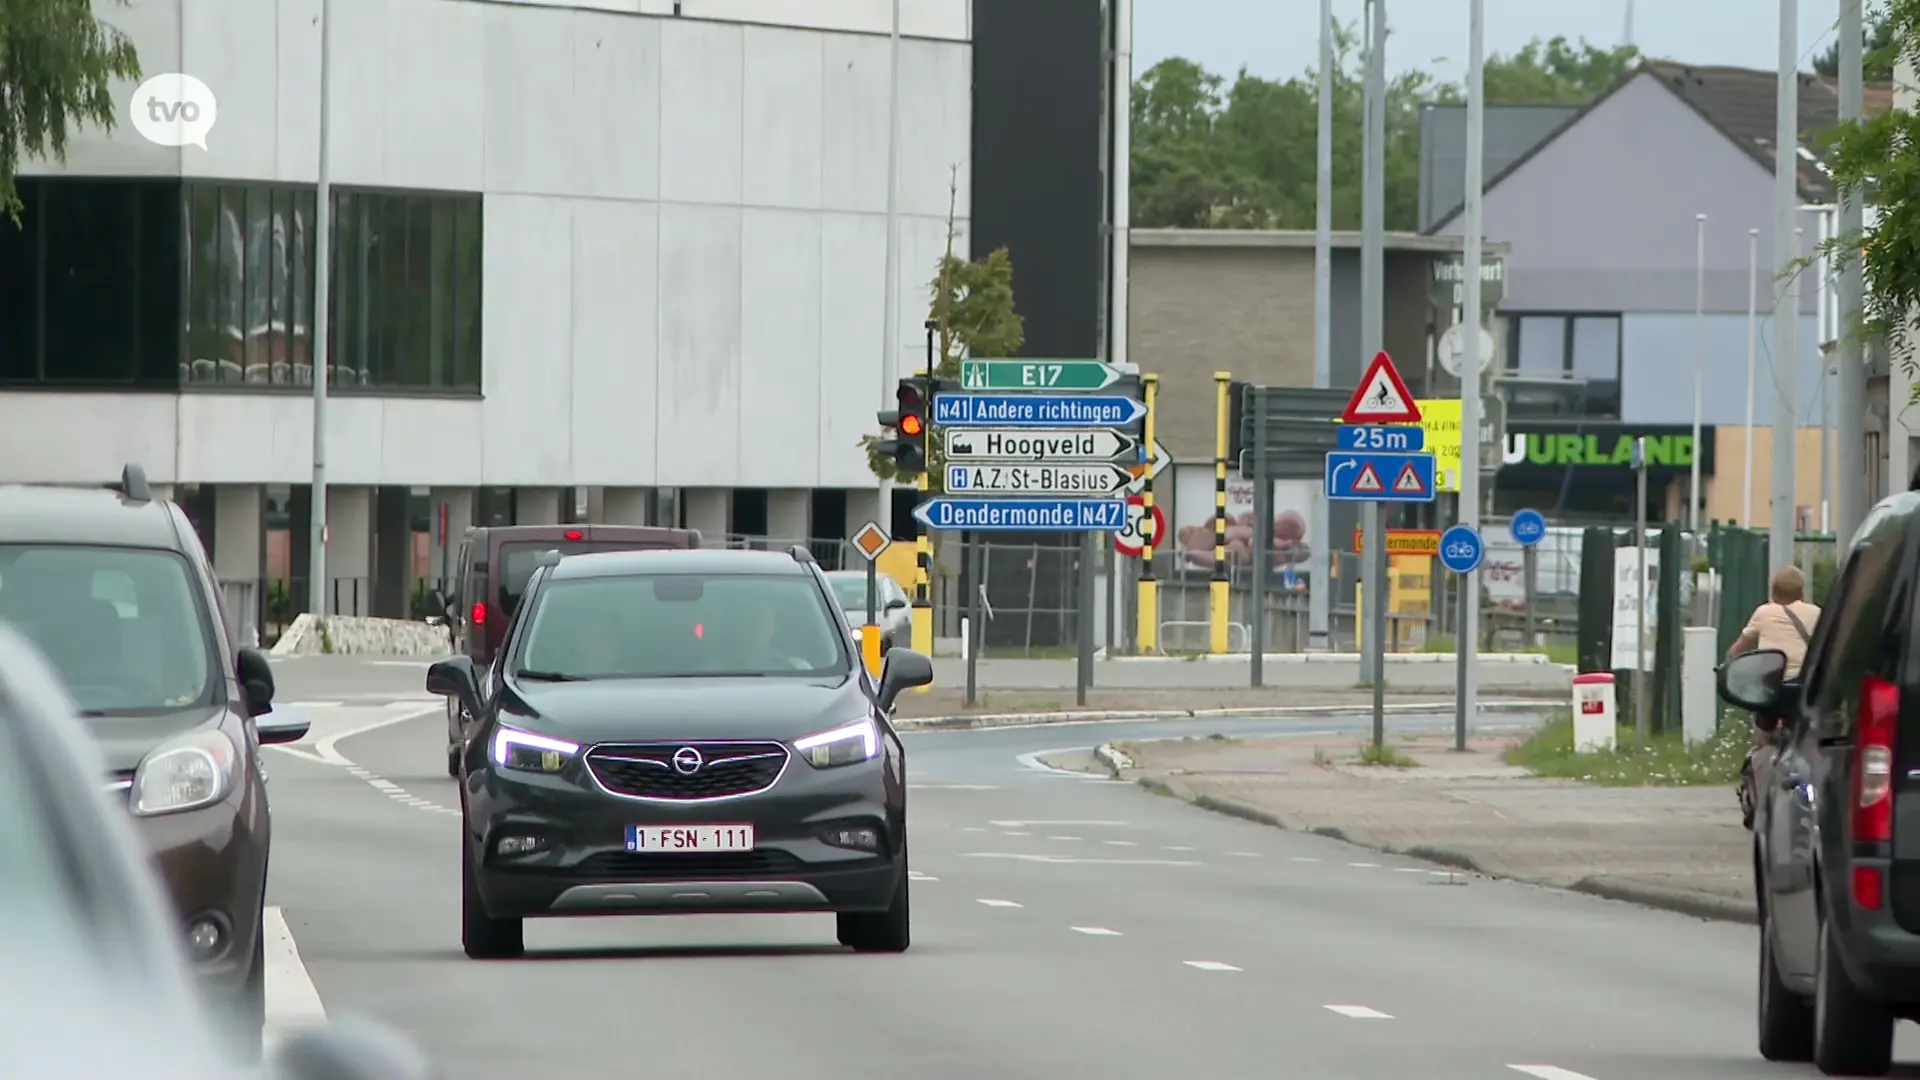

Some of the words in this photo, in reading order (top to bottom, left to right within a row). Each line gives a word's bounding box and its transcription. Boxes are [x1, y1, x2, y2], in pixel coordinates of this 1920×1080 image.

[1022, 366, 1063, 386] E17
[940, 401, 968, 419] N41
[976, 401, 1032, 419] Andere
[1039, 401, 1121, 423] richtingen
[987, 434, 1095, 460] Hoogveld
[1353, 427, 1408, 448] 25m
[1501, 434, 1702, 465] UURLAND
[973, 469, 1006, 489] A.Z.
[1012, 469, 1109, 489] St-Blasius
[940, 503, 1074, 525] Dendermonde
[1083, 503, 1120, 525] N47
[1120, 514, 1153, 538] 50
